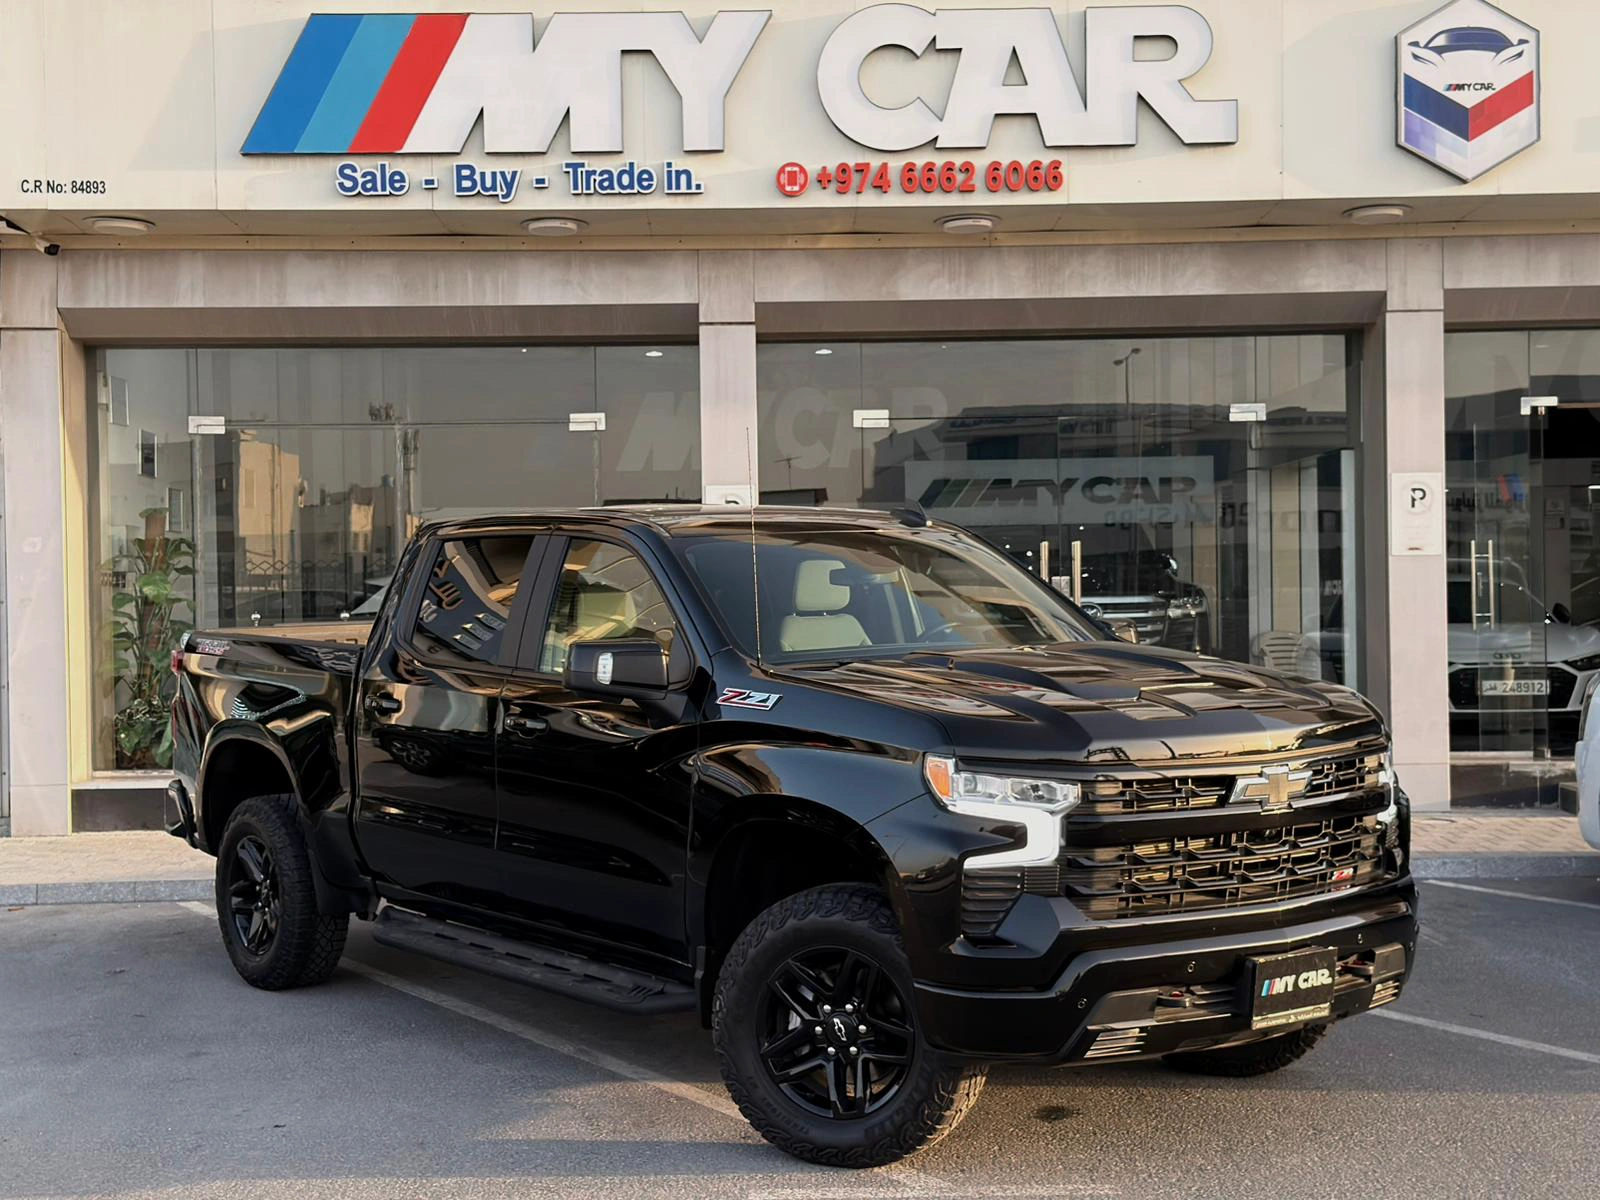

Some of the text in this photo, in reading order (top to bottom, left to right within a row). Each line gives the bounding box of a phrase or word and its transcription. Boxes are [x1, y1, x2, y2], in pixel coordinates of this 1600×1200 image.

[398, 3, 1238, 154] MY CAR
[1473, 83, 1496, 91] CAR
[21, 179, 106, 194] C.R No: 84893
[336, 160, 410, 196] Sale
[454, 162, 520, 203] Buy
[563, 161, 657, 195] Trade
[664, 161, 704, 195] in.
[816, 159, 1064, 194] +974 6662 6066
[716, 687, 784, 711] Z71
[1273, 968, 1332, 995] MY CAR
